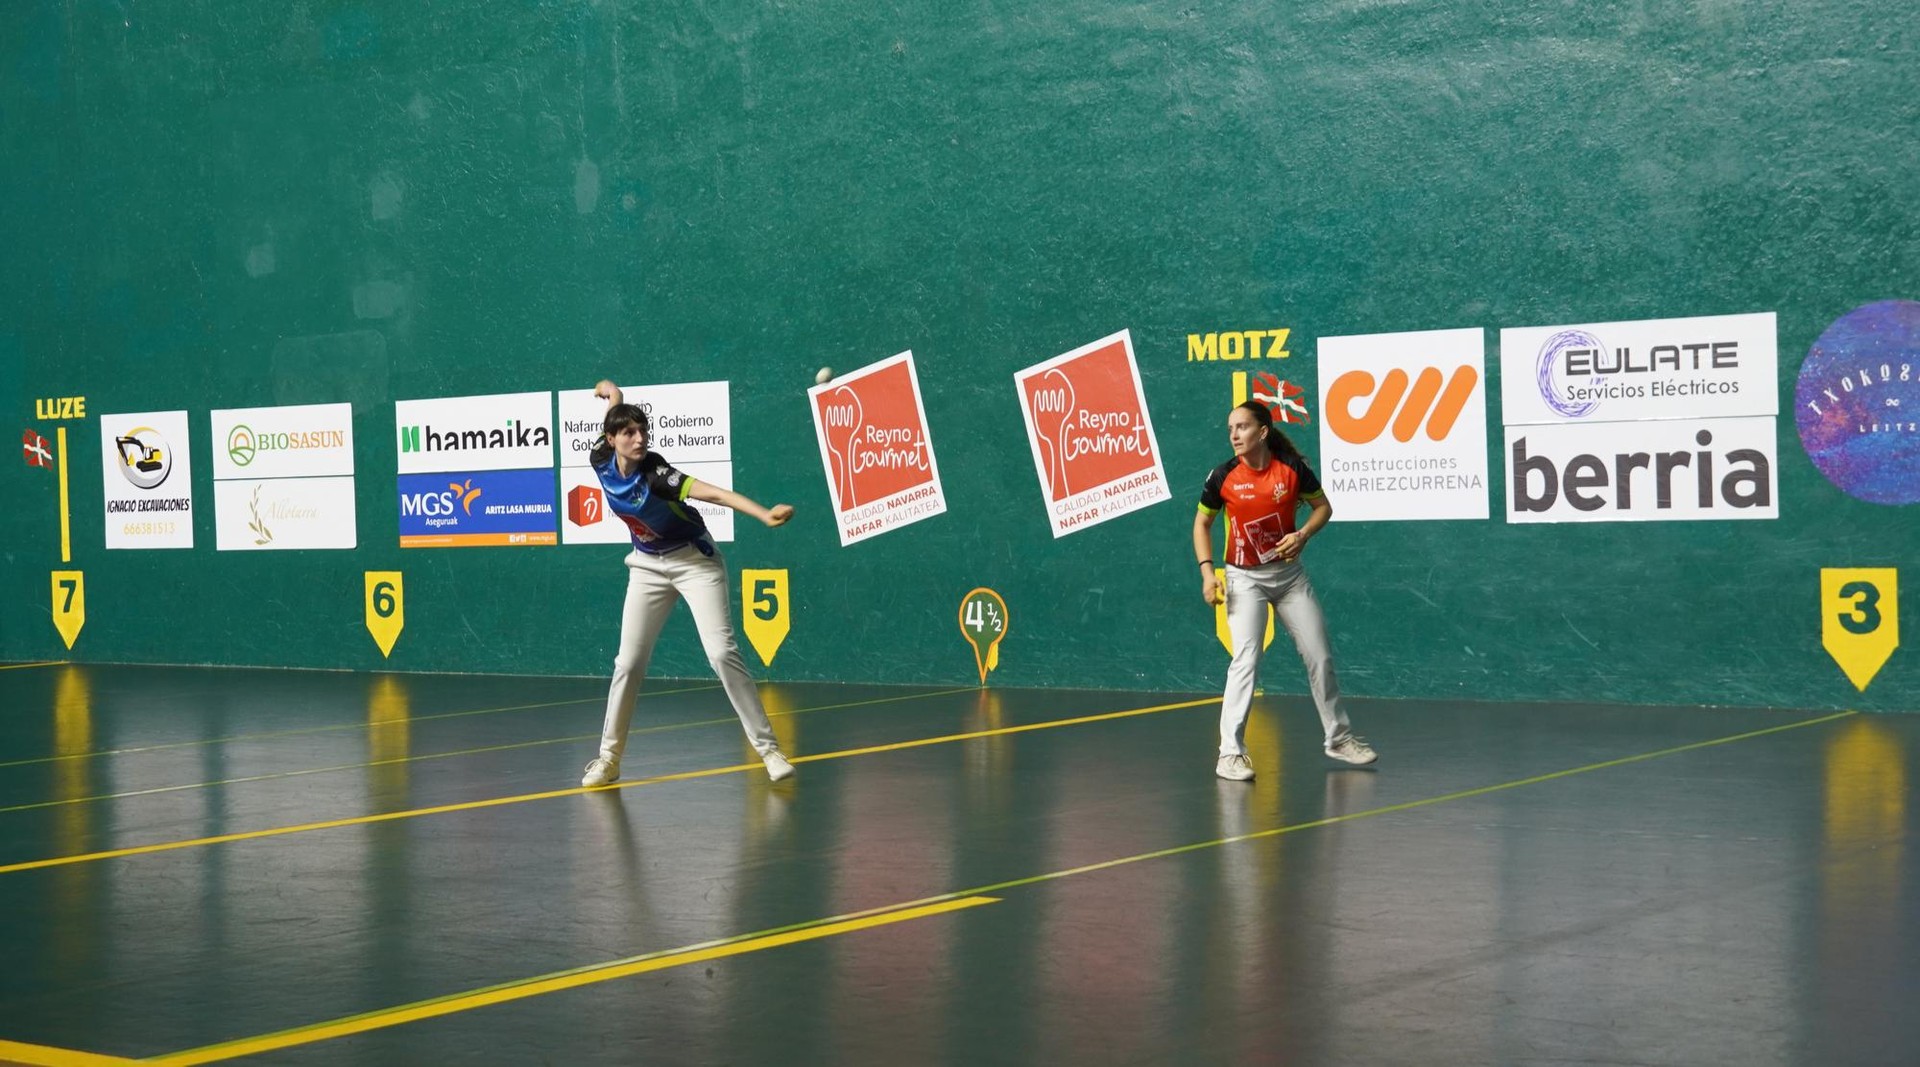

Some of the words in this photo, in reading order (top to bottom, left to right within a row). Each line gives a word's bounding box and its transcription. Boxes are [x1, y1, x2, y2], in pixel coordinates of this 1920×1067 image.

[1187, 328, 1291, 362] MOTZ
[1565, 341, 1738, 376] EULATE
[1567, 383, 1645, 401] Servicios
[1651, 379, 1740, 397] Eléctricos
[36, 397, 86, 420] LUZE
[658, 414, 714, 429] Gobierno
[1078, 409, 1130, 432] Reyno
[257, 430, 345, 451] BIOSASUN
[425, 420, 549, 452] hamaika
[659, 435, 674, 448] de
[678, 434, 725, 447] Navarra
[852, 430, 929, 474] Gourmet
[866, 425, 912, 447] Reyno
[1064, 413, 1150, 461] Gourmet
[1331, 455, 1458, 473] Construcciones
[1512, 429, 1770, 513] berria
[1055, 492, 1102, 516] CALIDAD
[1103, 471, 1159, 499] NAVARRA
[1331, 474, 1482, 492] MARIEZCURRENA
[107, 499, 136, 513] IGNACIO
[138, 498, 190, 513] EXCAVACIONES
[401, 491, 454, 517] MGS
[485, 505, 506, 515] ARITZ
[506, 505, 524, 514] LASA
[525, 504, 552, 514] MURUA
[843, 503, 885, 525] CALIDAD
[886, 485, 937, 511] NAVARRA
[846, 518, 883, 539] NAFAR
[884, 498, 941, 525] KALITATEA
[1059, 508, 1099, 530] NAFAR
[1101, 487, 1164, 515] KALITATEA
[425, 517, 458, 528] Aseguruak
[59, 580, 77, 613] 7
[373, 581, 395, 618] 6
[752, 580, 779, 621] 5
[1838, 581, 1881, 634] 3
